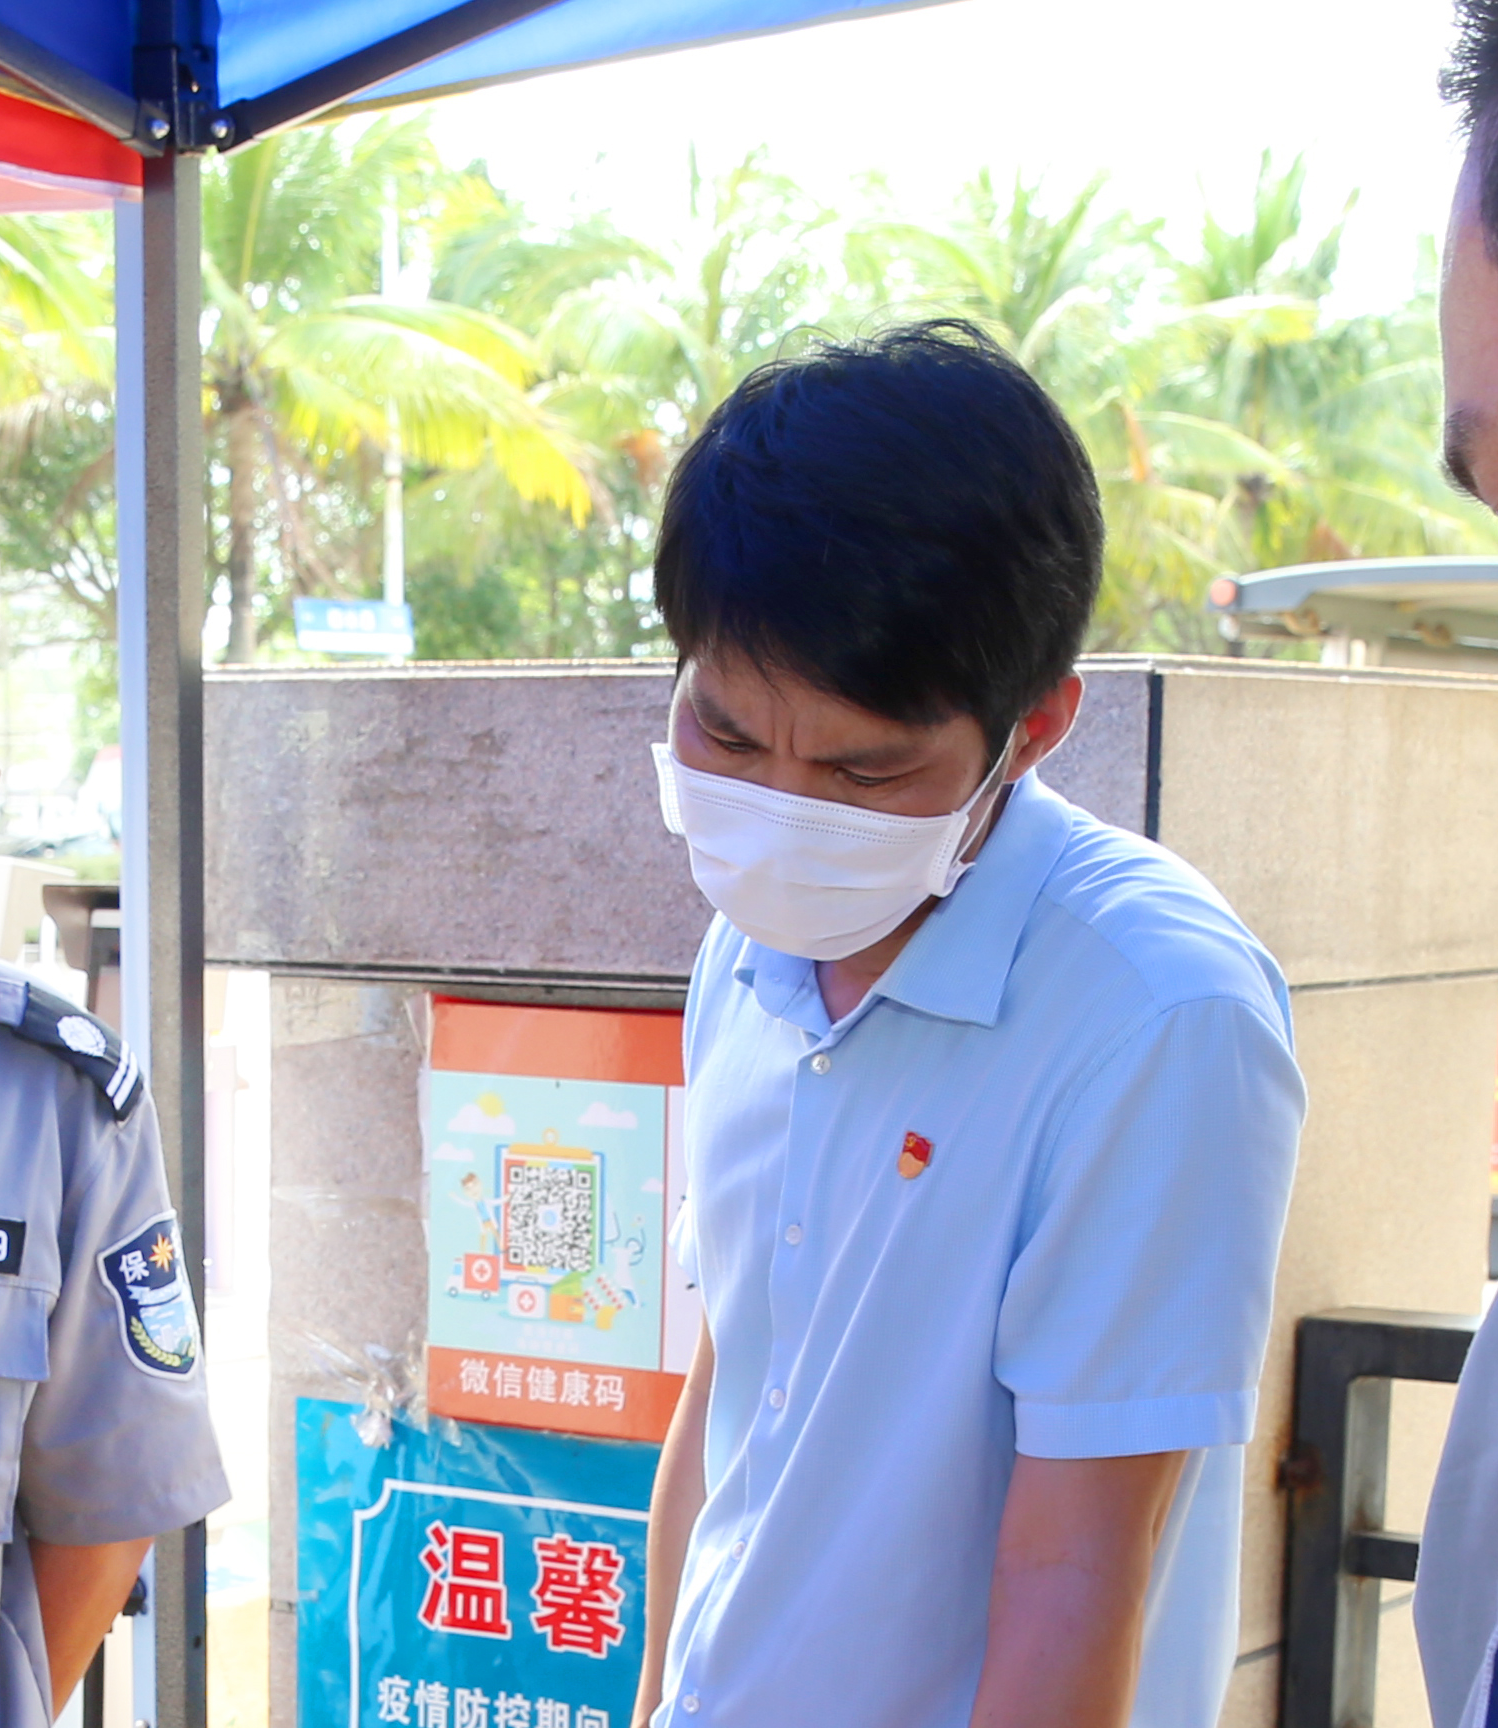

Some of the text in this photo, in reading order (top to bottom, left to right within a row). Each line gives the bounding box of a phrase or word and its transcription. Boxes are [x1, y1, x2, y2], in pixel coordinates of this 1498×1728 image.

[459, 1357, 626, 1411] 微信健康码
[418, 1520, 626, 1658] 温馨
